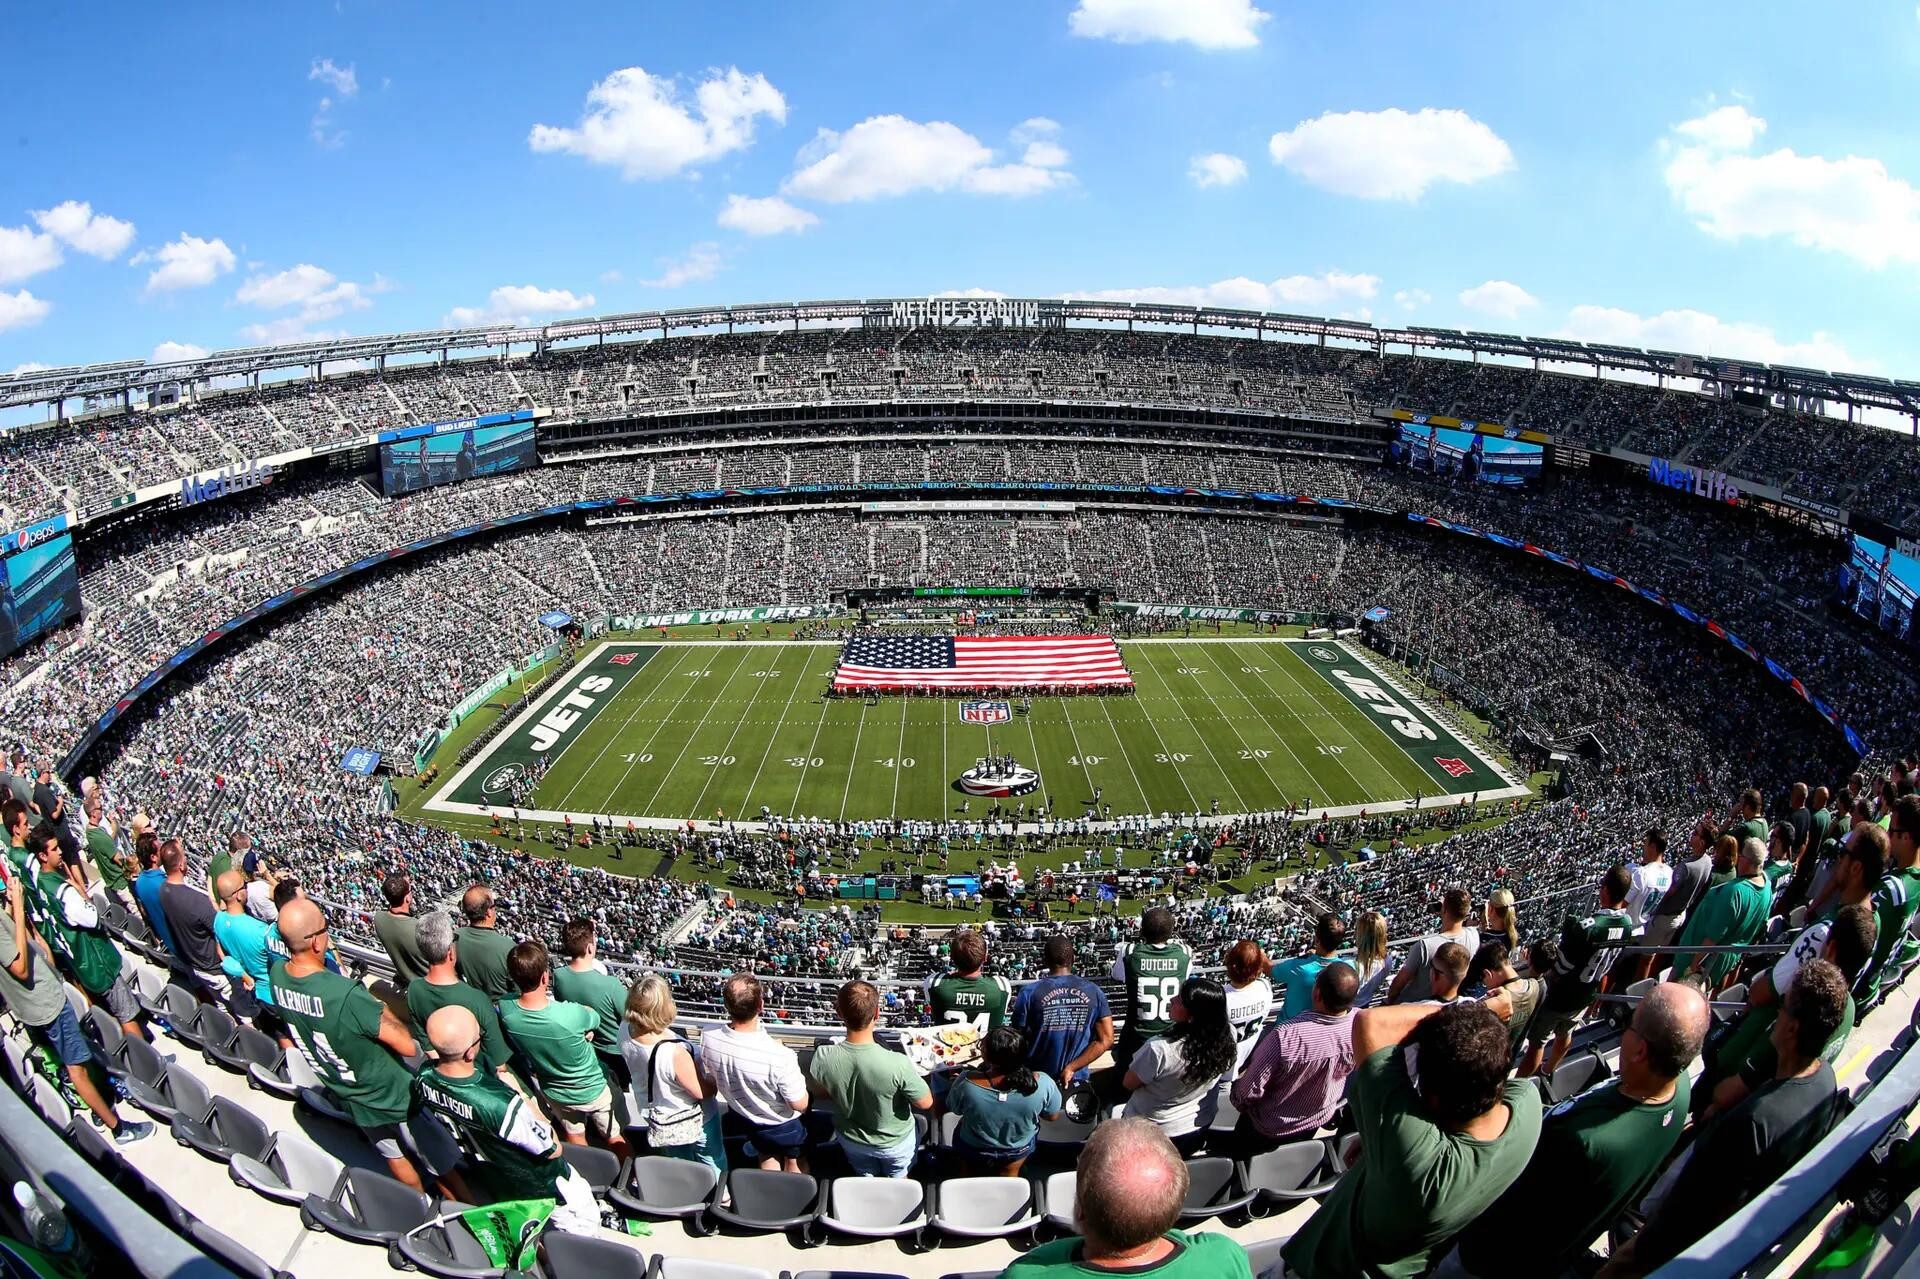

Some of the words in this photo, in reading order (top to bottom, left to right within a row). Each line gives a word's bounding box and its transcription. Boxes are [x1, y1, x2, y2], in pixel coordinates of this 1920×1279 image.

[893, 300, 960, 319] METLIFE
[967, 300, 1038, 319] STADIUM
[1412, 415, 1427, 424] SAP
[435, 423, 453, 433] BUD
[453, 420, 478, 431] LIGHT
[1459, 422, 1474, 431] SAP
[1503, 429, 1518, 438] SAP
[180, 458, 274, 508] MetLife
[828, 483, 858, 492] BROAD
[862, 482, 901, 491] STRIPES
[905, 481, 924, 490] AND
[1649, 456, 1739, 506] MetLife
[1800, 498, 1810, 507] OF
[1809, 500, 1822, 511] THE
[1821, 506, 1839, 517] JETS
[29, 521, 56, 546] pepsi
[645, 612, 695, 627] NEW
[699, 608, 757, 624] YORK
[758, 605, 813, 619] JETS
[1135, 604, 1187, 616] NEW
[1188, 606, 1244, 619] YORK
[1331, 669, 1438, 741] JETS
[528, 674, 614, 752] JETS
[966, 709, 1006, 722] NFL
[1236, 748, 1269, 760] 20
[1315, 744, 1343, 756] 10
[623, 752, 654, 764] 10
[702, 755, 737, 766] 20
[790, 756, 825, 768] 30
[882, 757, 916, 768] 40
[1066, 754, 1100, 766] 40
[1154, 752, 1187, 763] 30
[1140, 958, 1179, 971] BUTCHER
[955, 992, 986, 1006] REVIS
[1040, 987, 1069, 1007] JOHNNY
[1070, 988, 1091, 1004] CASH
[1061, 997, 1081, 1005] TOUR
[1137, 976, 1180, 1022] 58
[1230, 1000, 1266, 1020] BUTCHER
[287, 1022, 357, 1083] 14
